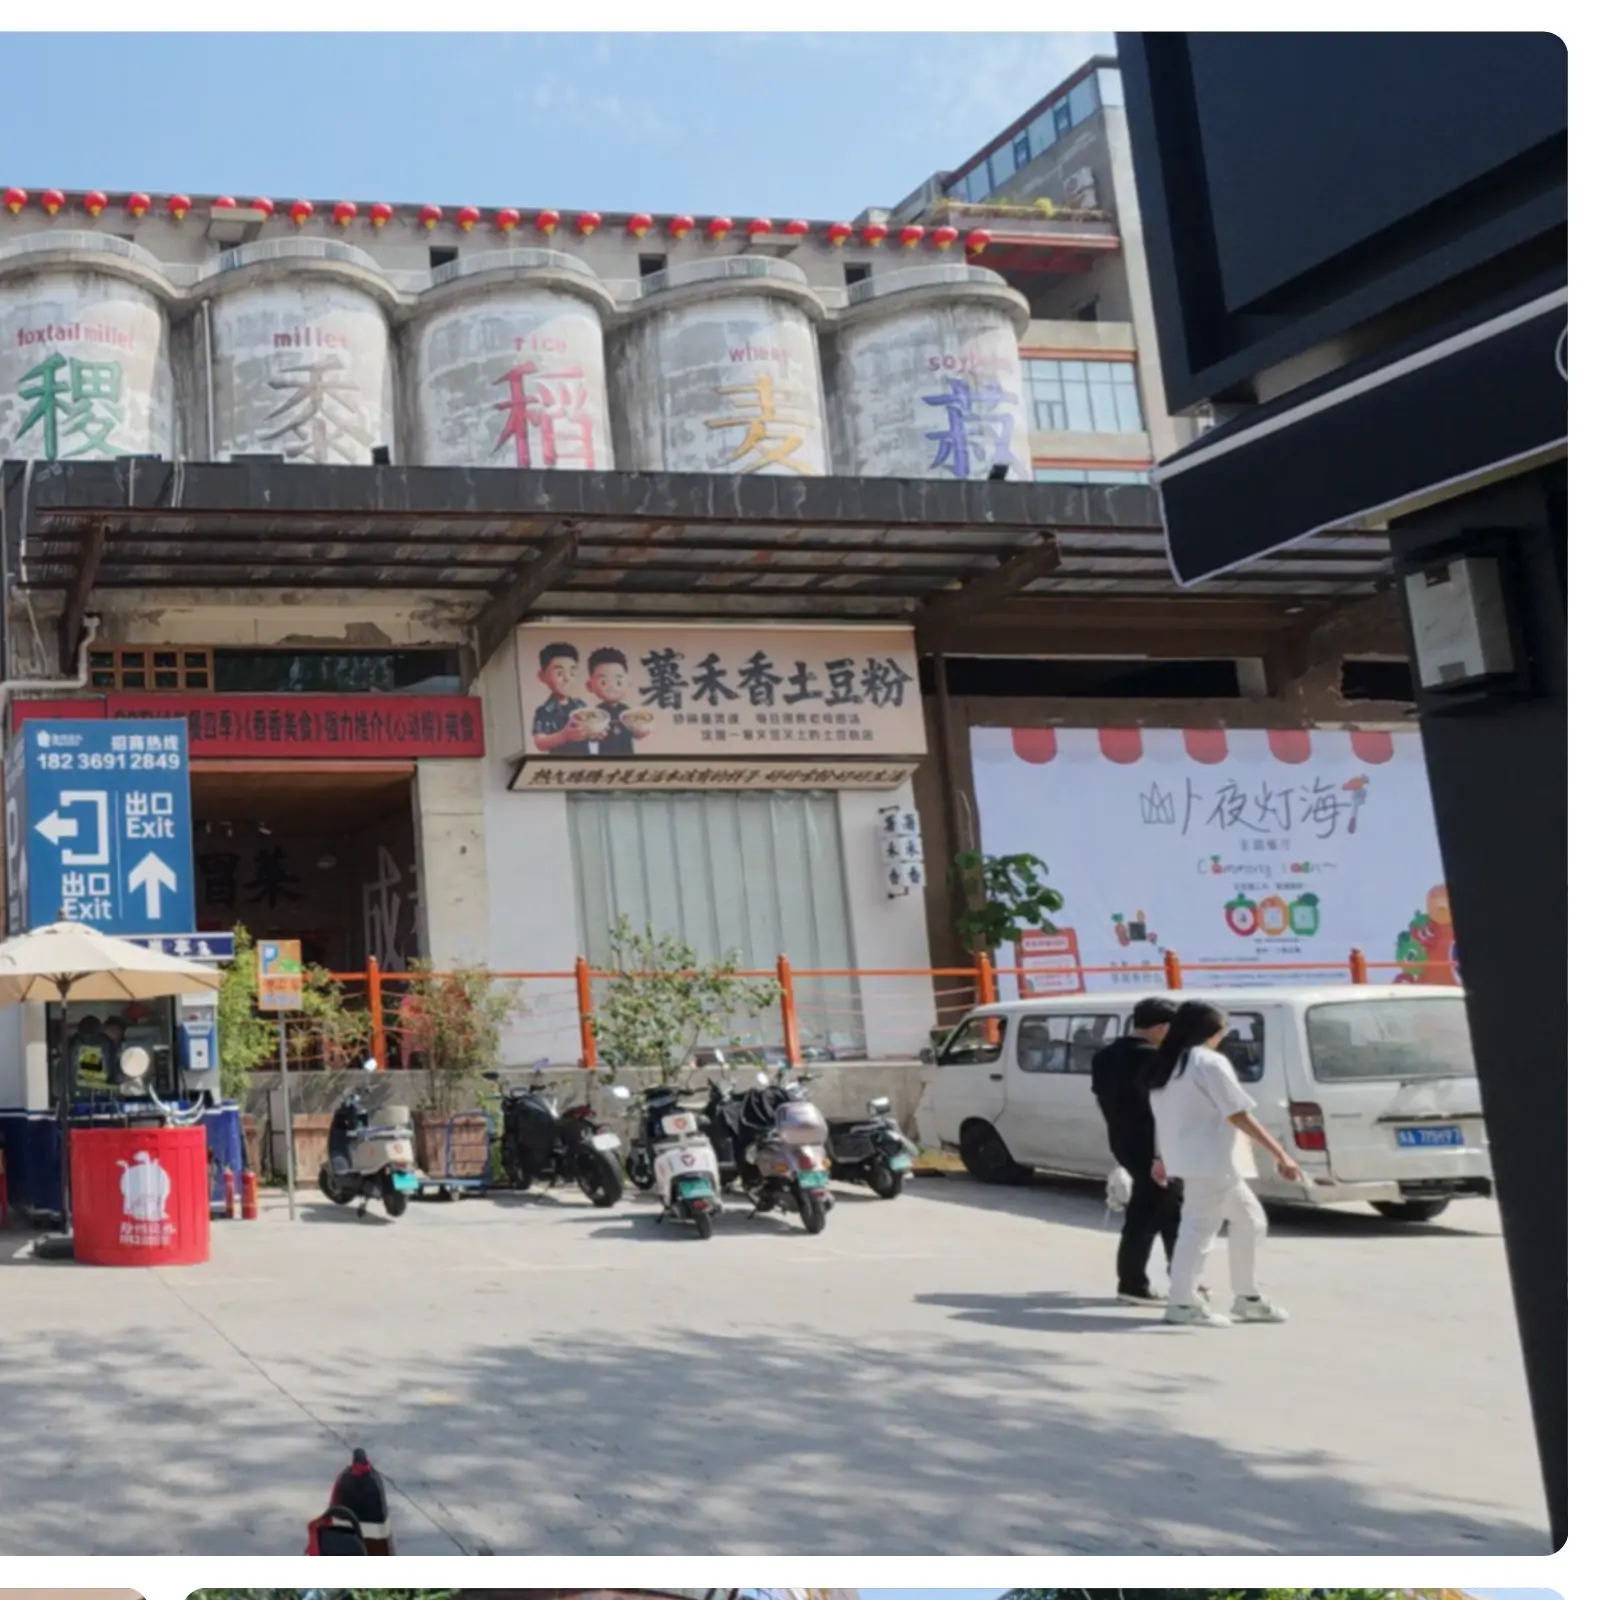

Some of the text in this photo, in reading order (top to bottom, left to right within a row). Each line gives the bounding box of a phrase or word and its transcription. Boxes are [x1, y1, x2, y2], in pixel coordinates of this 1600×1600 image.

[17, 324, 81, 348] foxtail
[492, 360, 595, 470] 稻
[638, 647, 915, 710] 薯禾香土豆粉
[111, 734, 179, 751] 招商热线
[37, 753, 180, 770] 182 3691 2849
[125, 790, 173, 815] 出口
[126, 816, 175, 839] Exit
[61, 871, 110, 897] 出口
[63, 897, 113, 920] Exit
